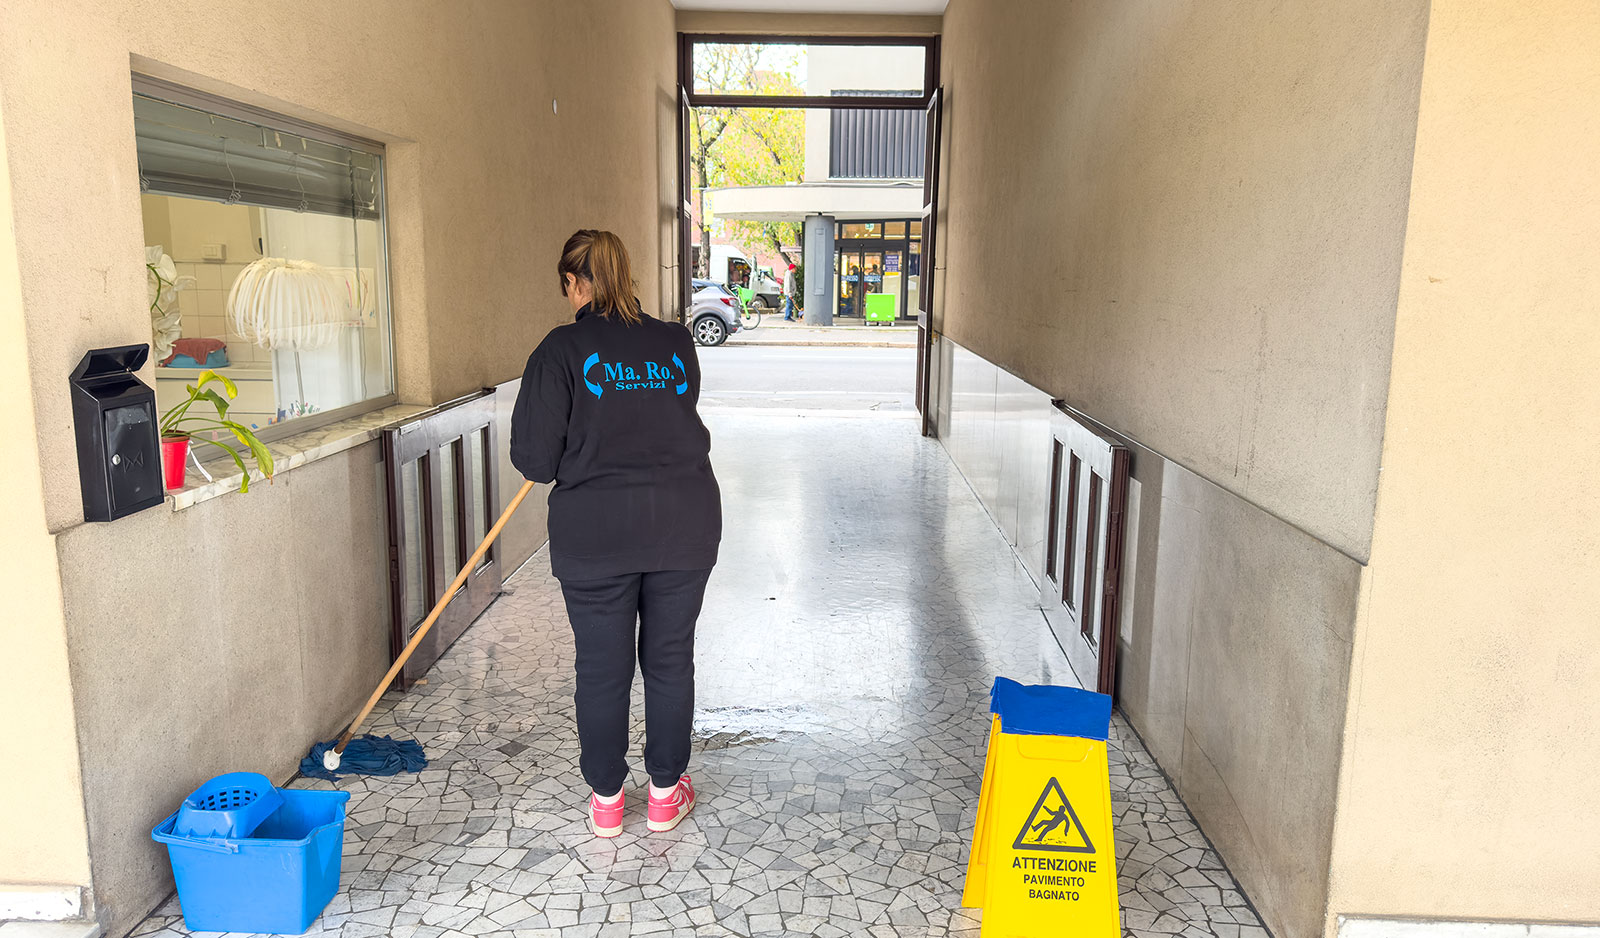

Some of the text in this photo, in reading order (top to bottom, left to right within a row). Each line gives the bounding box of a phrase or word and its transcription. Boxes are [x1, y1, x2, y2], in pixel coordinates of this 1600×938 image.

[602, 361, 675, 382] Ma. Ro.
[615, 380, 666, 391] Servizi
[1012, 857, 1097, 873] ATTENZIONE
[1023, 874, 1085, 888] PAVIMENTO
[1028, 889, 1080, 902] BAGNATO
